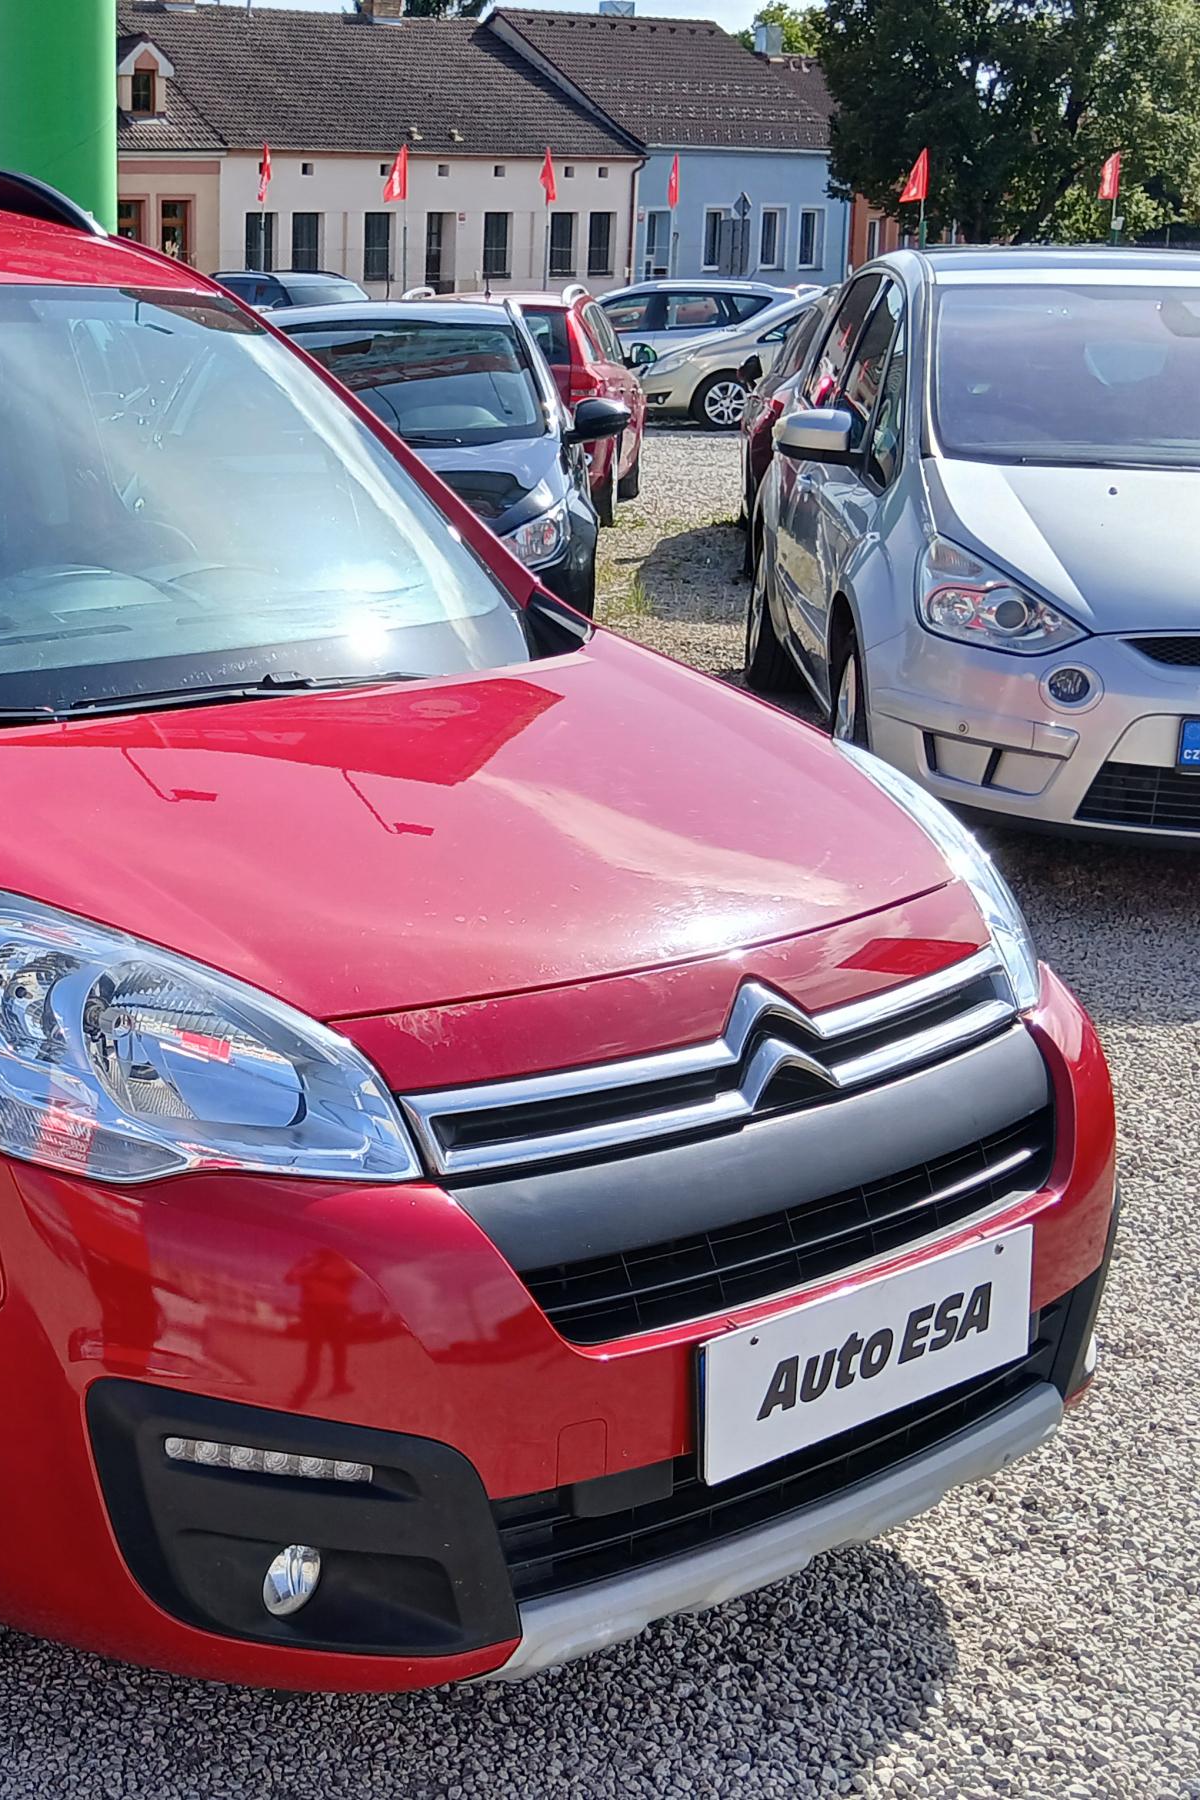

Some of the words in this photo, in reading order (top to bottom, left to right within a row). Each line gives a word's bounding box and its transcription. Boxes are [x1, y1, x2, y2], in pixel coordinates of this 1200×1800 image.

[1183, 749, 1200, 760] CZ
[757, 1328, 894, 1421] Auto
[897, 1281, 993, 1365] ESA
